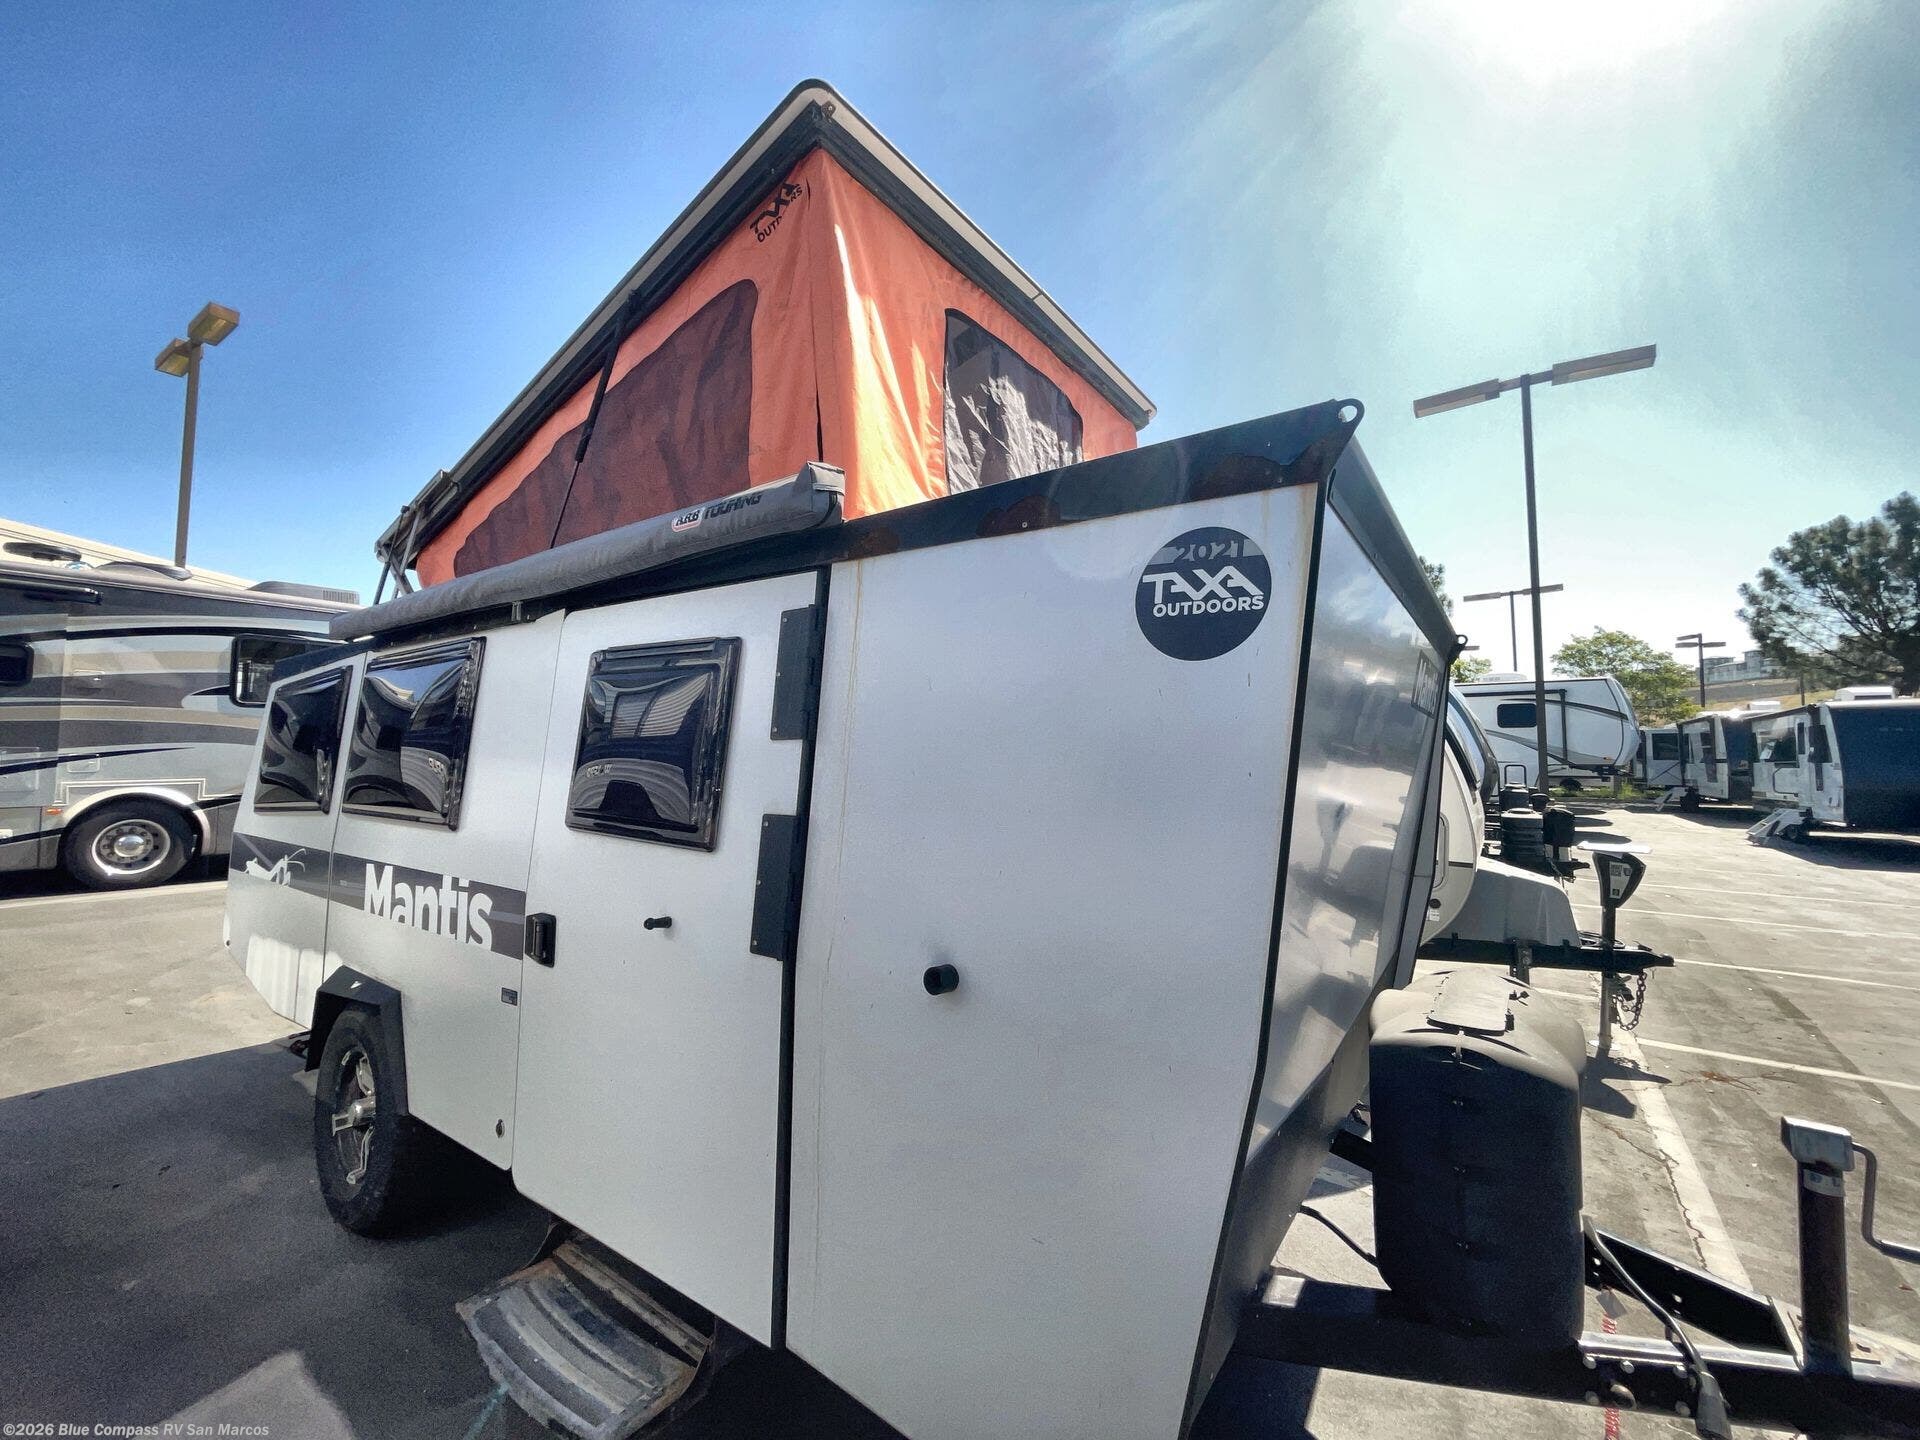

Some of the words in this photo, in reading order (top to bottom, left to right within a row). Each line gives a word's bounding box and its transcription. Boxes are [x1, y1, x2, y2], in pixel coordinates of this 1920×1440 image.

[675, 509, 701, 526] ARB
[704, 492, 763, 520] TOURING
[1143, 565, 1264, 604] TAXA
[1153, 595, 1264, 618] OUTDOORS
[364, 863, 493, 951] Mantis
